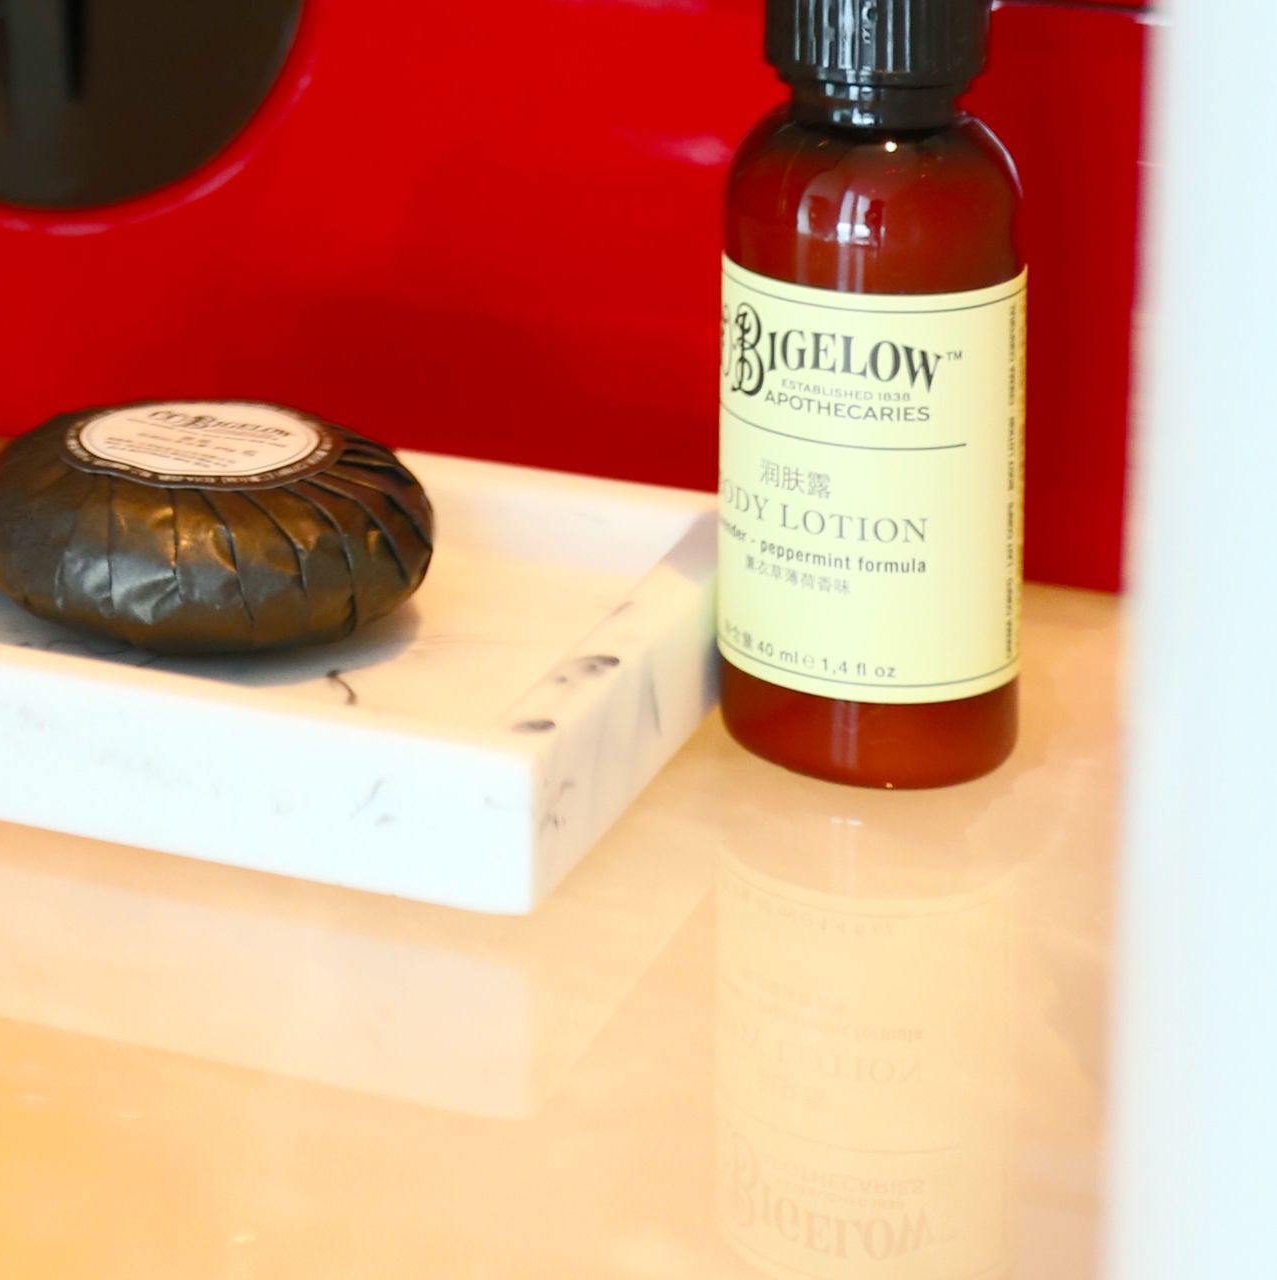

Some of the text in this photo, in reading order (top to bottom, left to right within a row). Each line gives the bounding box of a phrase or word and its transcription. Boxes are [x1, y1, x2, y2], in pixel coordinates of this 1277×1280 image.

[764, 389, 931, 422] APOTHECARIES
[780, 378, 911, 403] ESTABLISHED 1838
[759, 457, 833, 500] 润肤露
[778, 502, 930, 544] LOTION
[759, 539, 852, 572] peppermint
[857, 555, 928, 575] formula
[756, 641, 775, 658] 40
[856, 661, 868, 678] fl
[874, 665, 898, 680] oz
